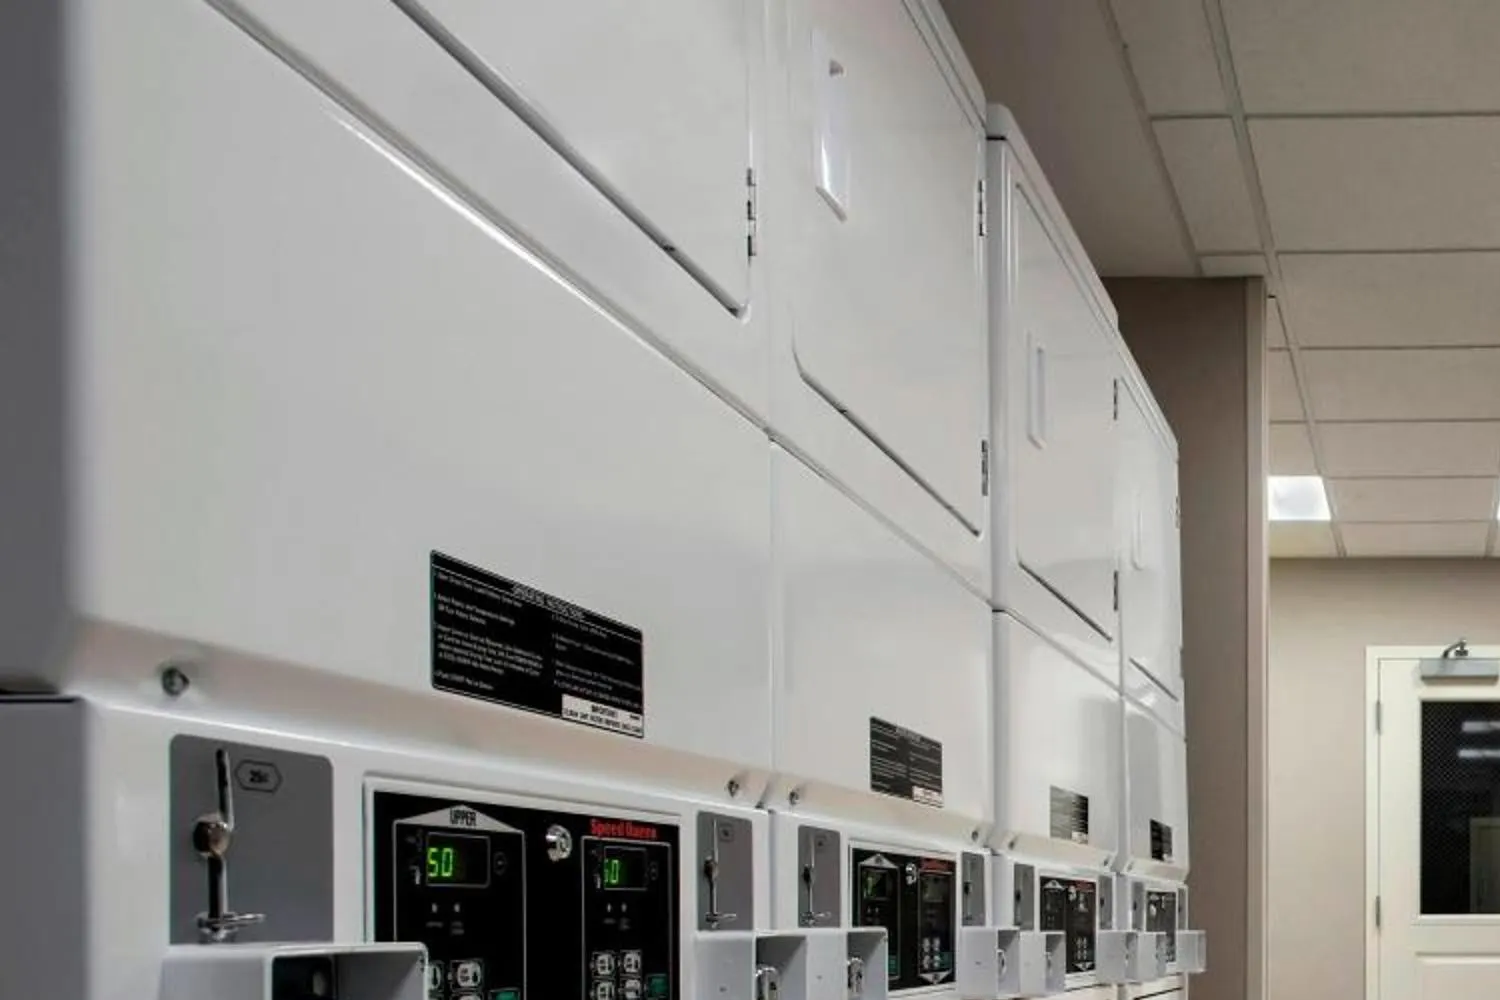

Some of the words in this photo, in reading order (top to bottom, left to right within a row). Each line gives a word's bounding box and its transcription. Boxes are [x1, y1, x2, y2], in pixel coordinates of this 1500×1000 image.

[450, 807, 476, 826] UPPER
[591, 818, 624, 837] Speed
[626, 822, 657, 838] Queen
[427, 847, 454, 877] 50
